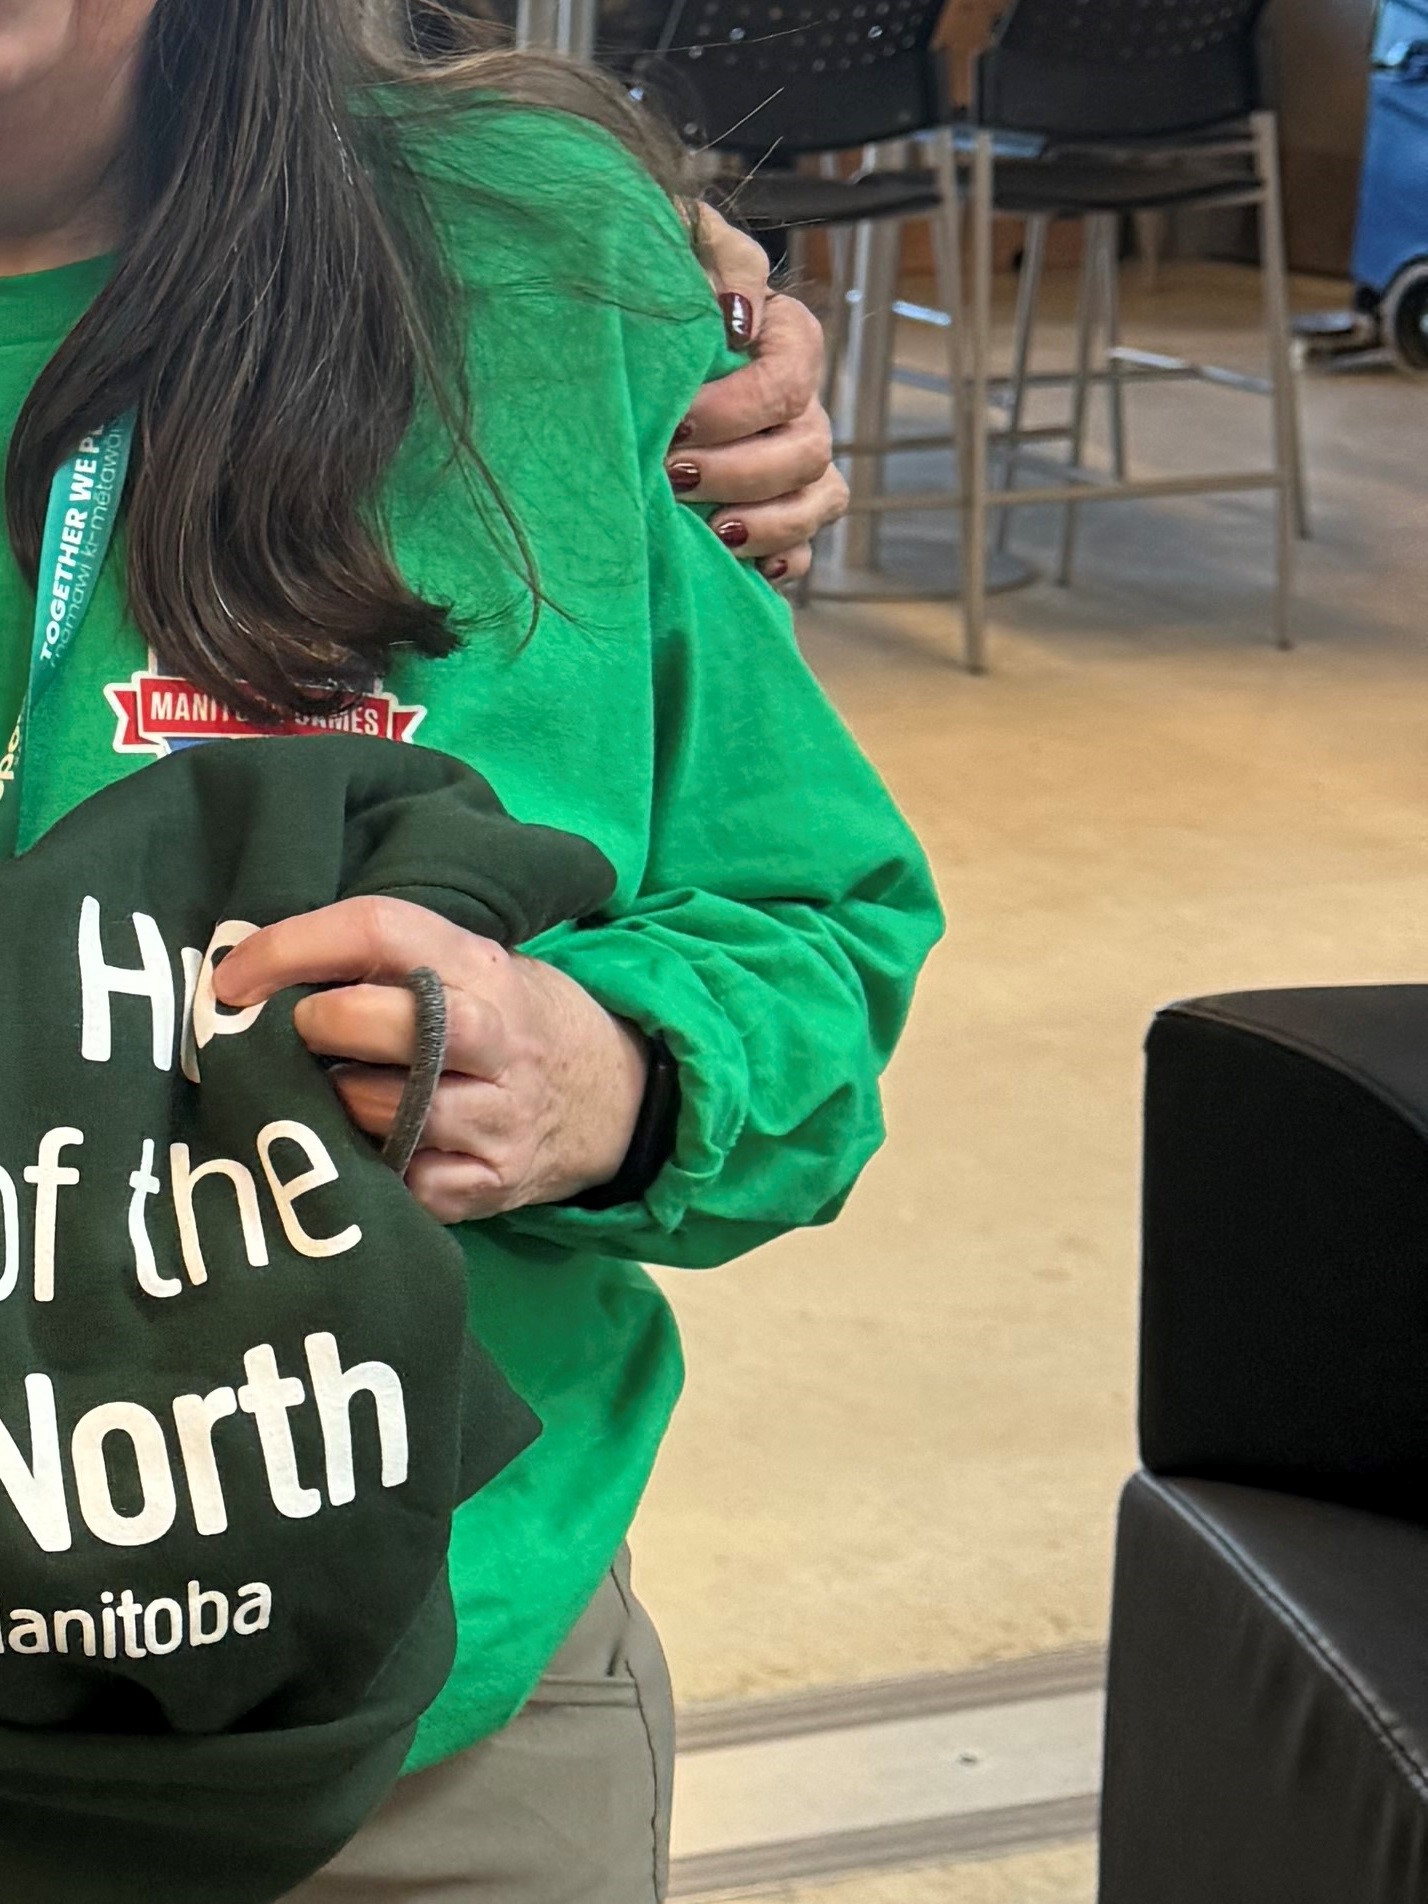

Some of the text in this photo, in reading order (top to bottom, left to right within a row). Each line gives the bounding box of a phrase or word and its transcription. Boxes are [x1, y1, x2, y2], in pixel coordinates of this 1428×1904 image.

[39, 423, 104, 662] TOGETHER WE PL
[150, 691, 283, 724] MANI
[128, 1119, 363, 1298] the
